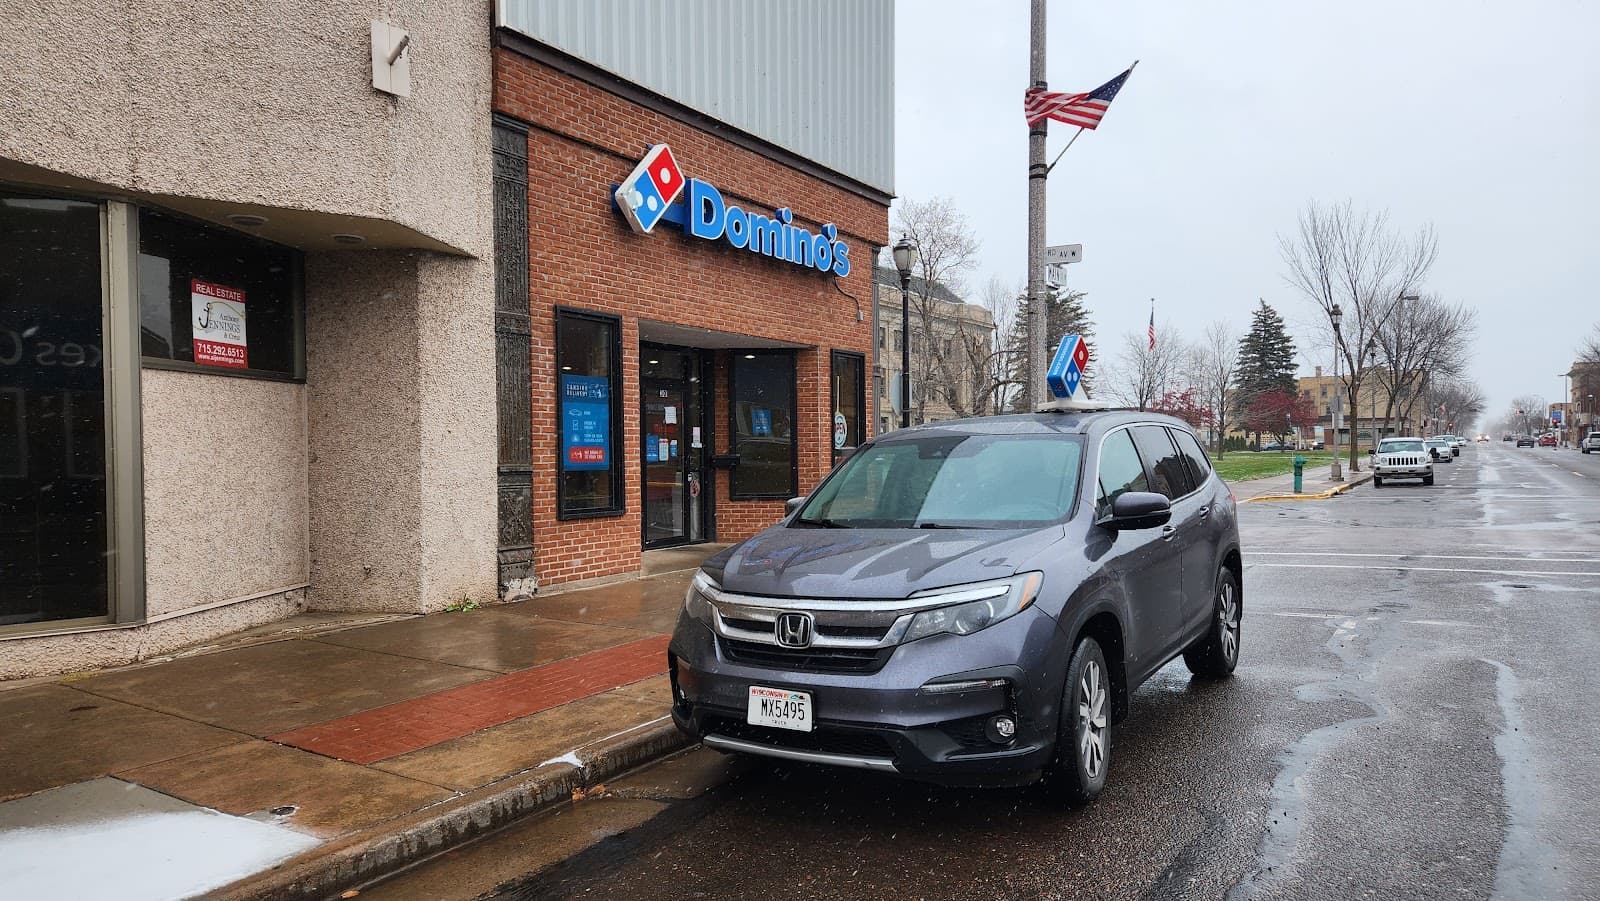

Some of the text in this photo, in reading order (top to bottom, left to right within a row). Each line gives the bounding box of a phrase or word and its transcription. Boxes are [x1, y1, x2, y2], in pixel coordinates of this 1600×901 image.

[690, 178, 850, 277] Domino's
[1060, 250, 1067, 258] AV
[195, 283, 241, 301] REAL ESTATE
[198, 343, 244, 358] 715.292.6513
[751, 688, 783, 698] WISCONSIN
[761, 698, 805, 721] MX5495
